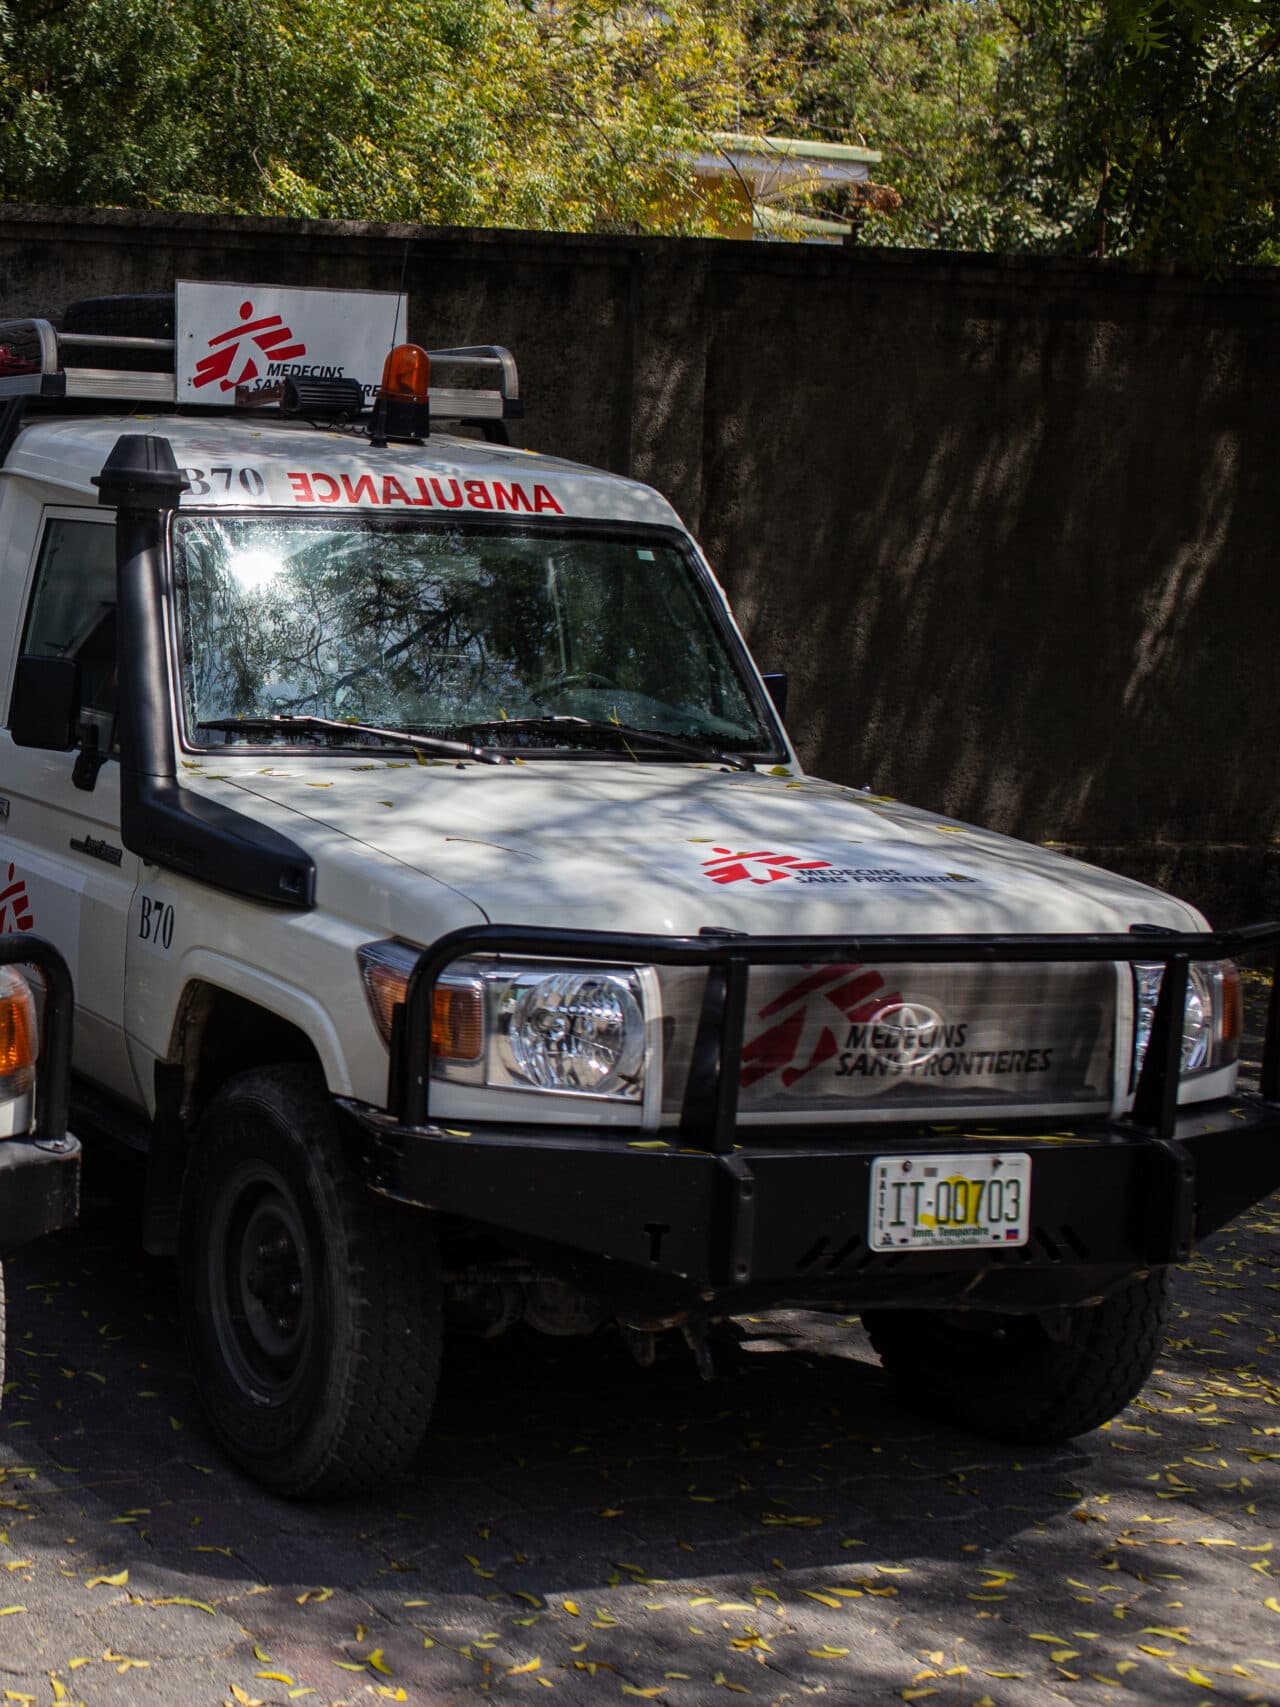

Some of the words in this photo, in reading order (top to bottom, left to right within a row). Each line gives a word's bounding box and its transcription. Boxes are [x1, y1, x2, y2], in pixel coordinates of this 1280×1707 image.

[265, 363, 345, 379] MEDECINS
[799, 869, 901, 877] MEDECINS
[138, 895, 175, 950] B70
[845, 1023, 969, 1049] MEDECINS
[909, 1048, 1053, 1077] FRONTIERES
[889, 1178, 1021, 1227] IT-00703
[912, 1229, 935, 1237] Imm.
[938, 1226, 990, 1237] Temporaire
